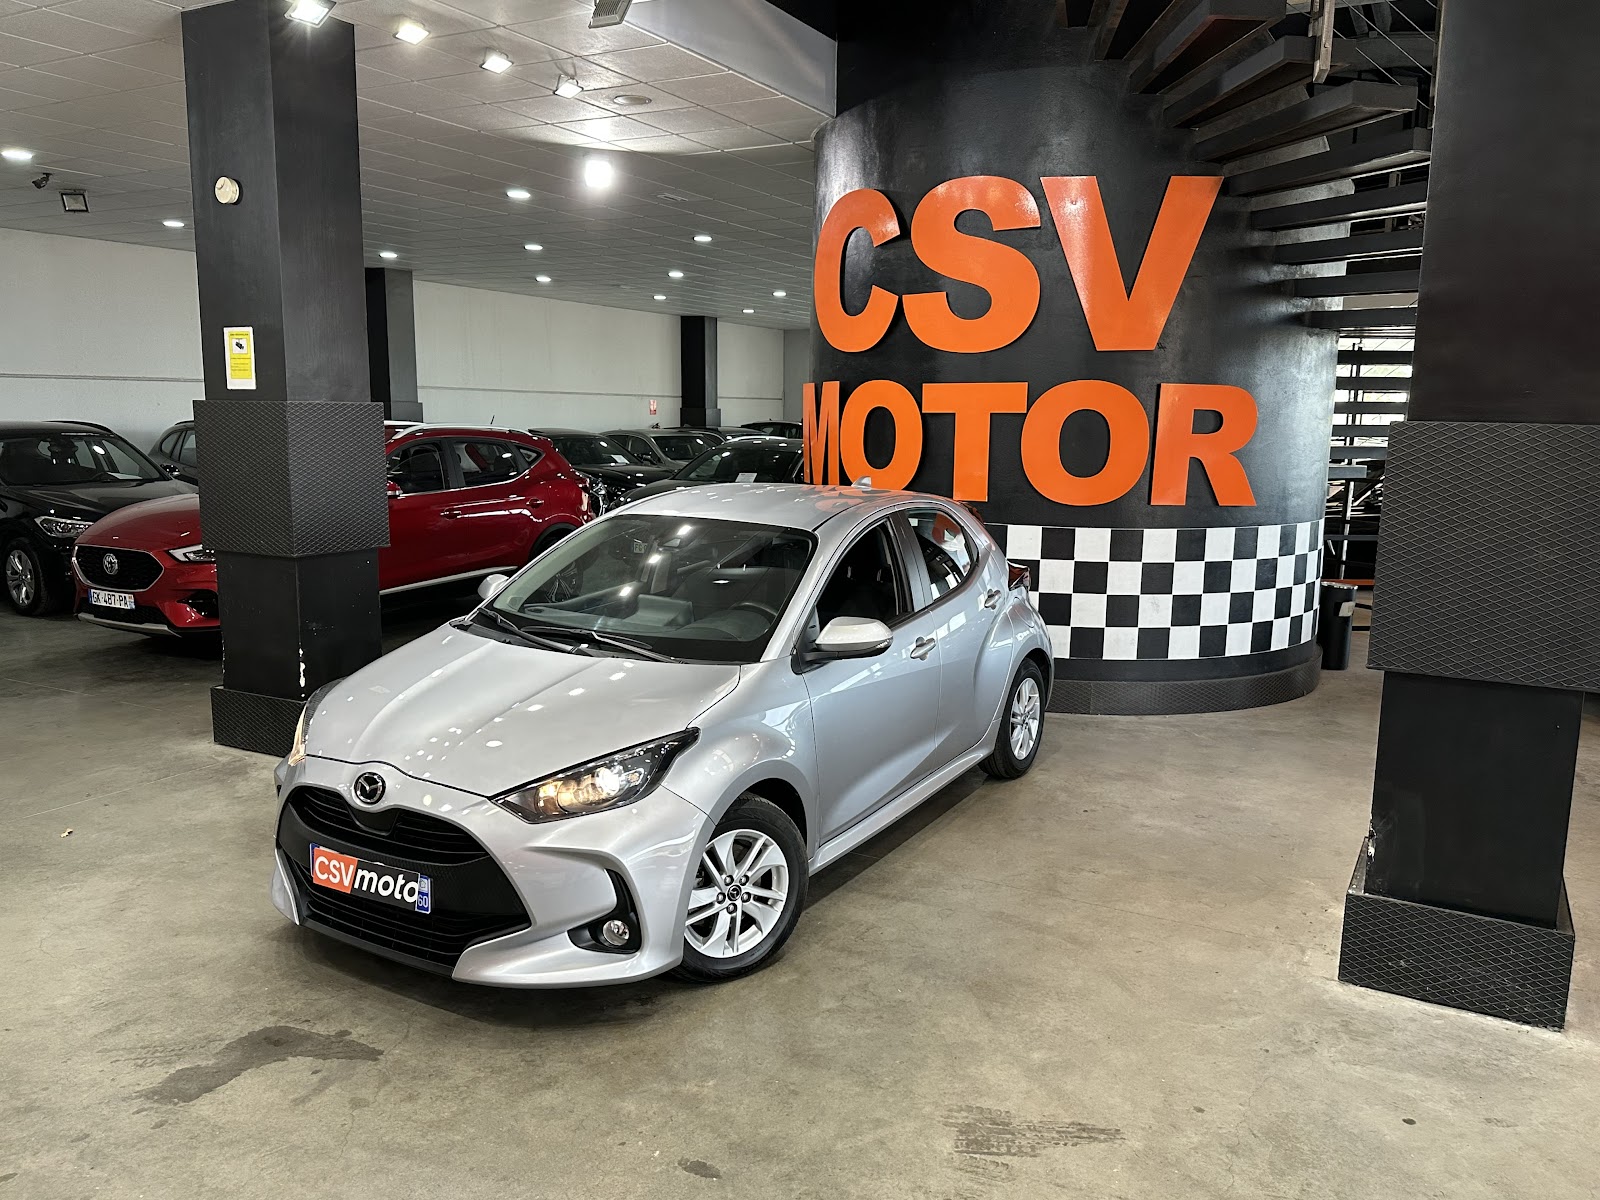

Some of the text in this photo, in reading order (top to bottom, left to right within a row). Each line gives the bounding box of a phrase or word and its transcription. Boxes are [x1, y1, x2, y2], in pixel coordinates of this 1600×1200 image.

[814, 175, 1224, 353] CSV
[803, 379, 1258, 506] MOTOR
[417, 894, 429, 909] 60
